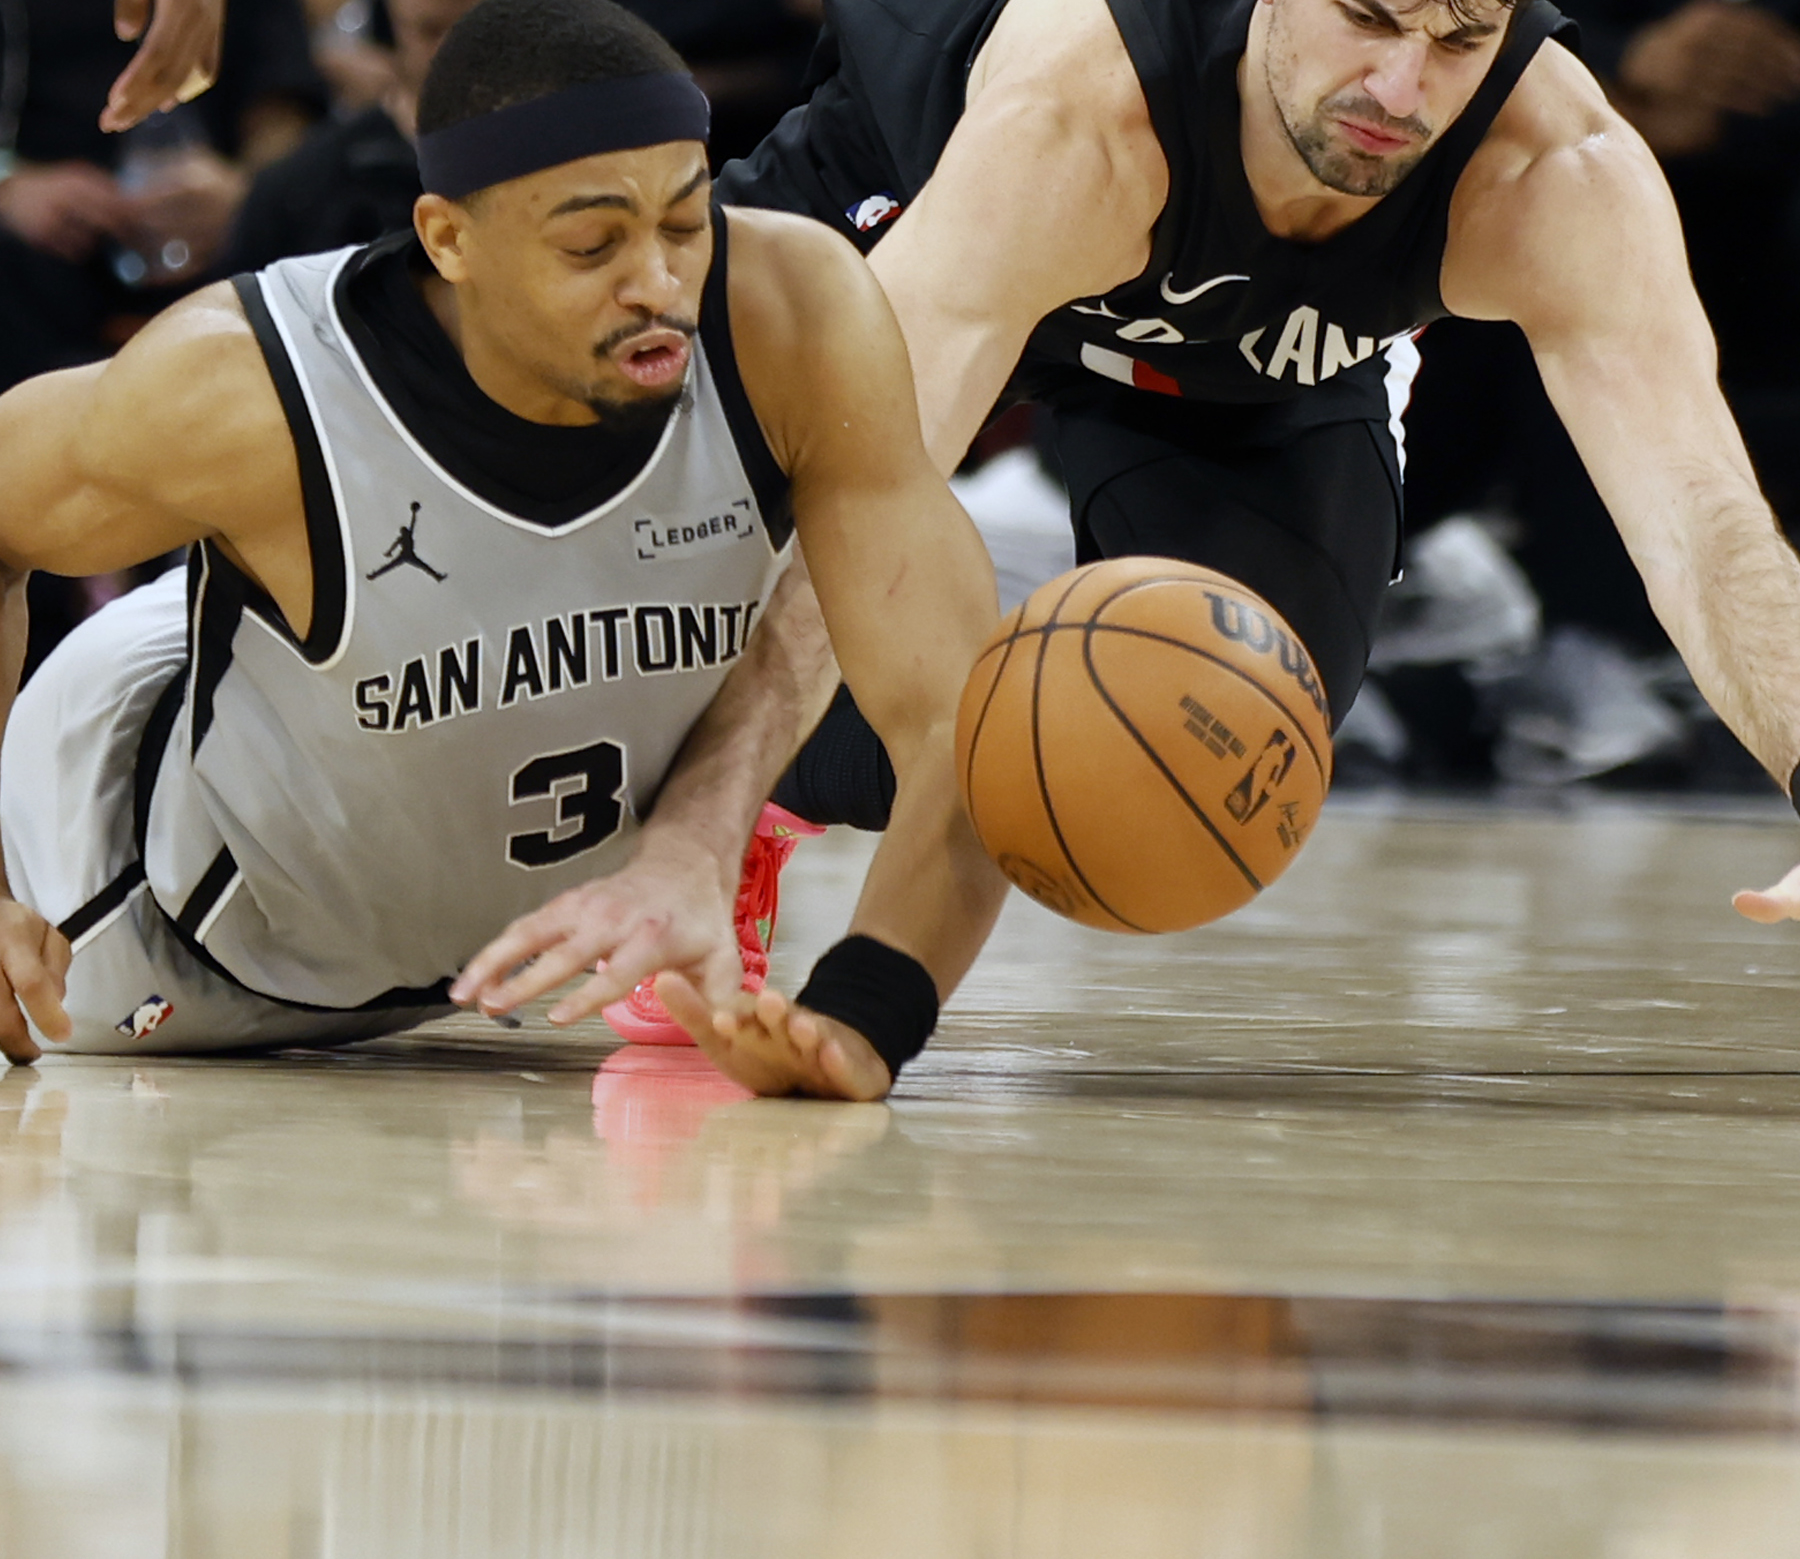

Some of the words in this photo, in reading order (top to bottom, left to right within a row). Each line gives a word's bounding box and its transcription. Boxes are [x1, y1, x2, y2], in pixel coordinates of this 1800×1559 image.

[652, 513, 738, 548] LEDGER
[353, 633, 484, 734] SAN
[506, 738, 627, 871] 3
